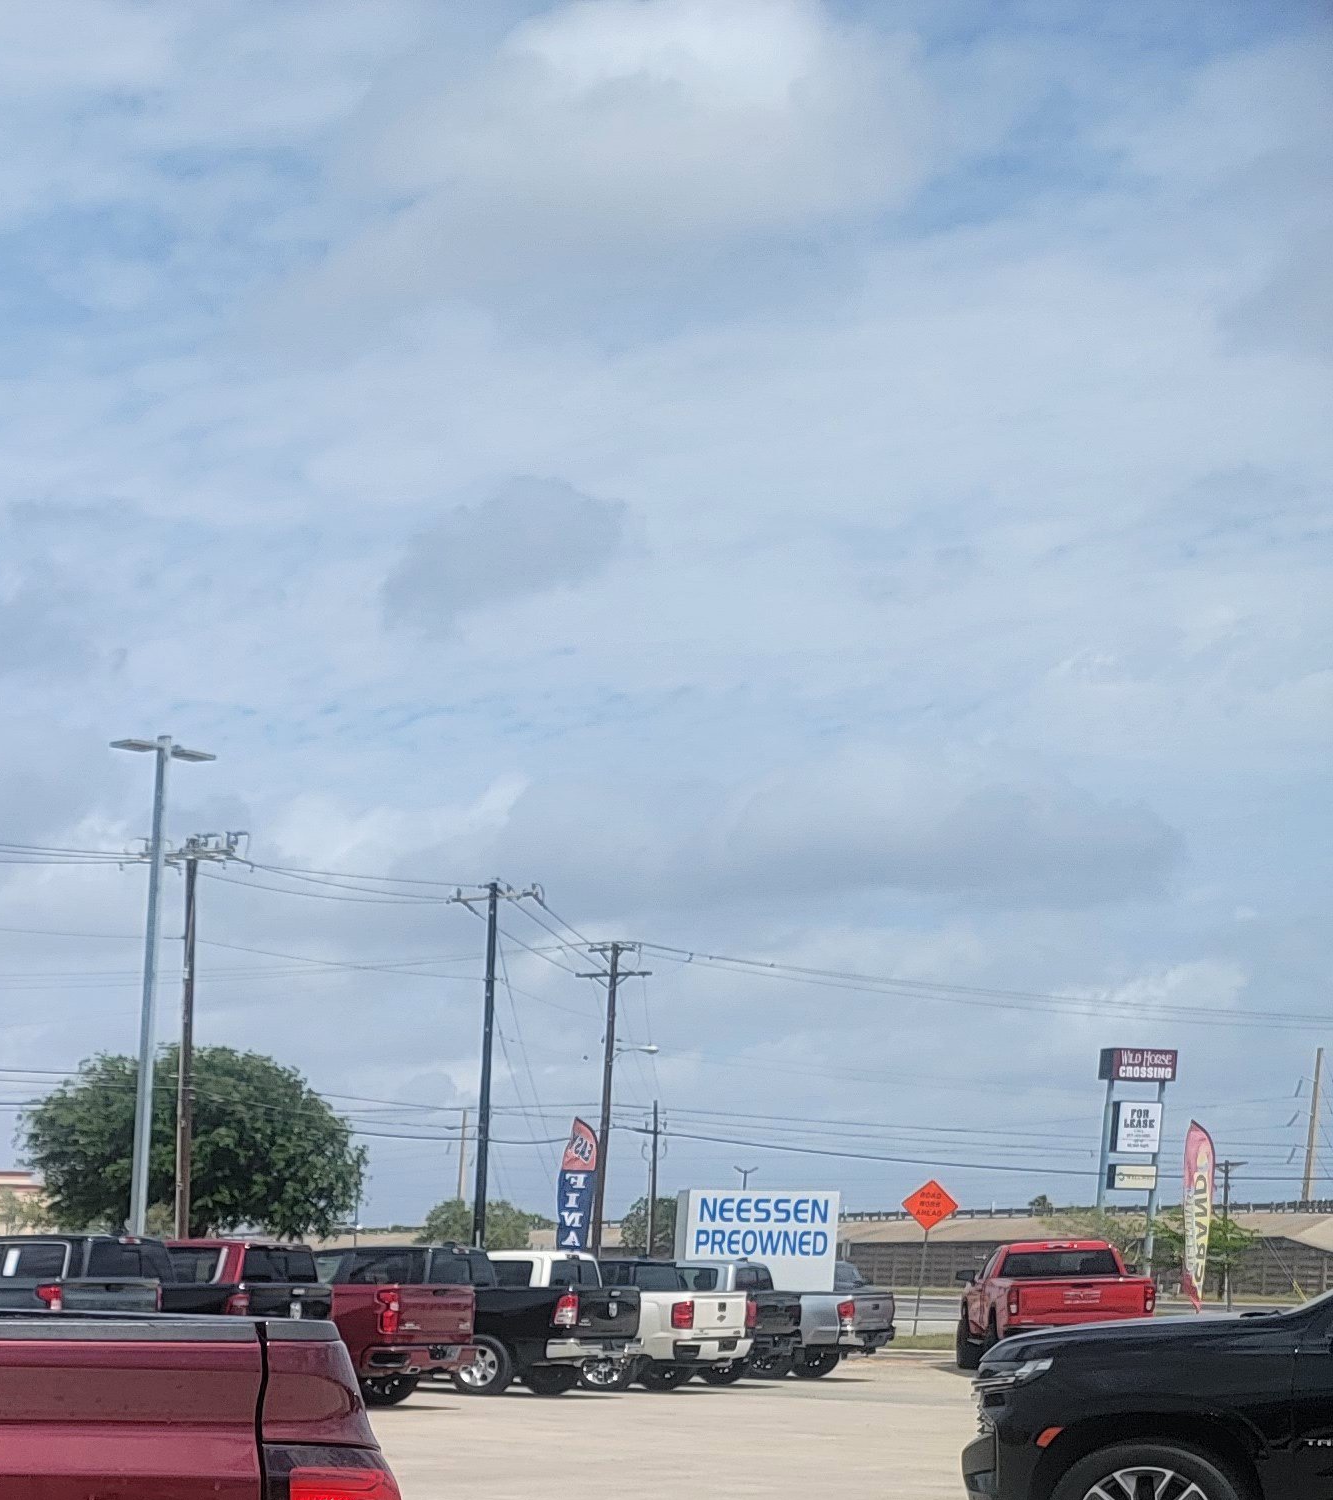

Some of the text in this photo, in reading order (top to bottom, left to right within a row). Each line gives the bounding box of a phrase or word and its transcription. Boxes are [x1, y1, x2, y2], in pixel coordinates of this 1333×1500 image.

[1121, 1050, 1173, 1066] WILD HORSE
[1119, 1066, 1173, 1079] CROSSING
[1130, 1108, 1149, 1119] FOR
[1124, 1118, 1155, 1129] LEASE
[699, 1197, 829, 1224] NEESSEN
[916, 1209, 943, 1217] AHEAD
[695, 1229, 828, 1256] PREOWNED
